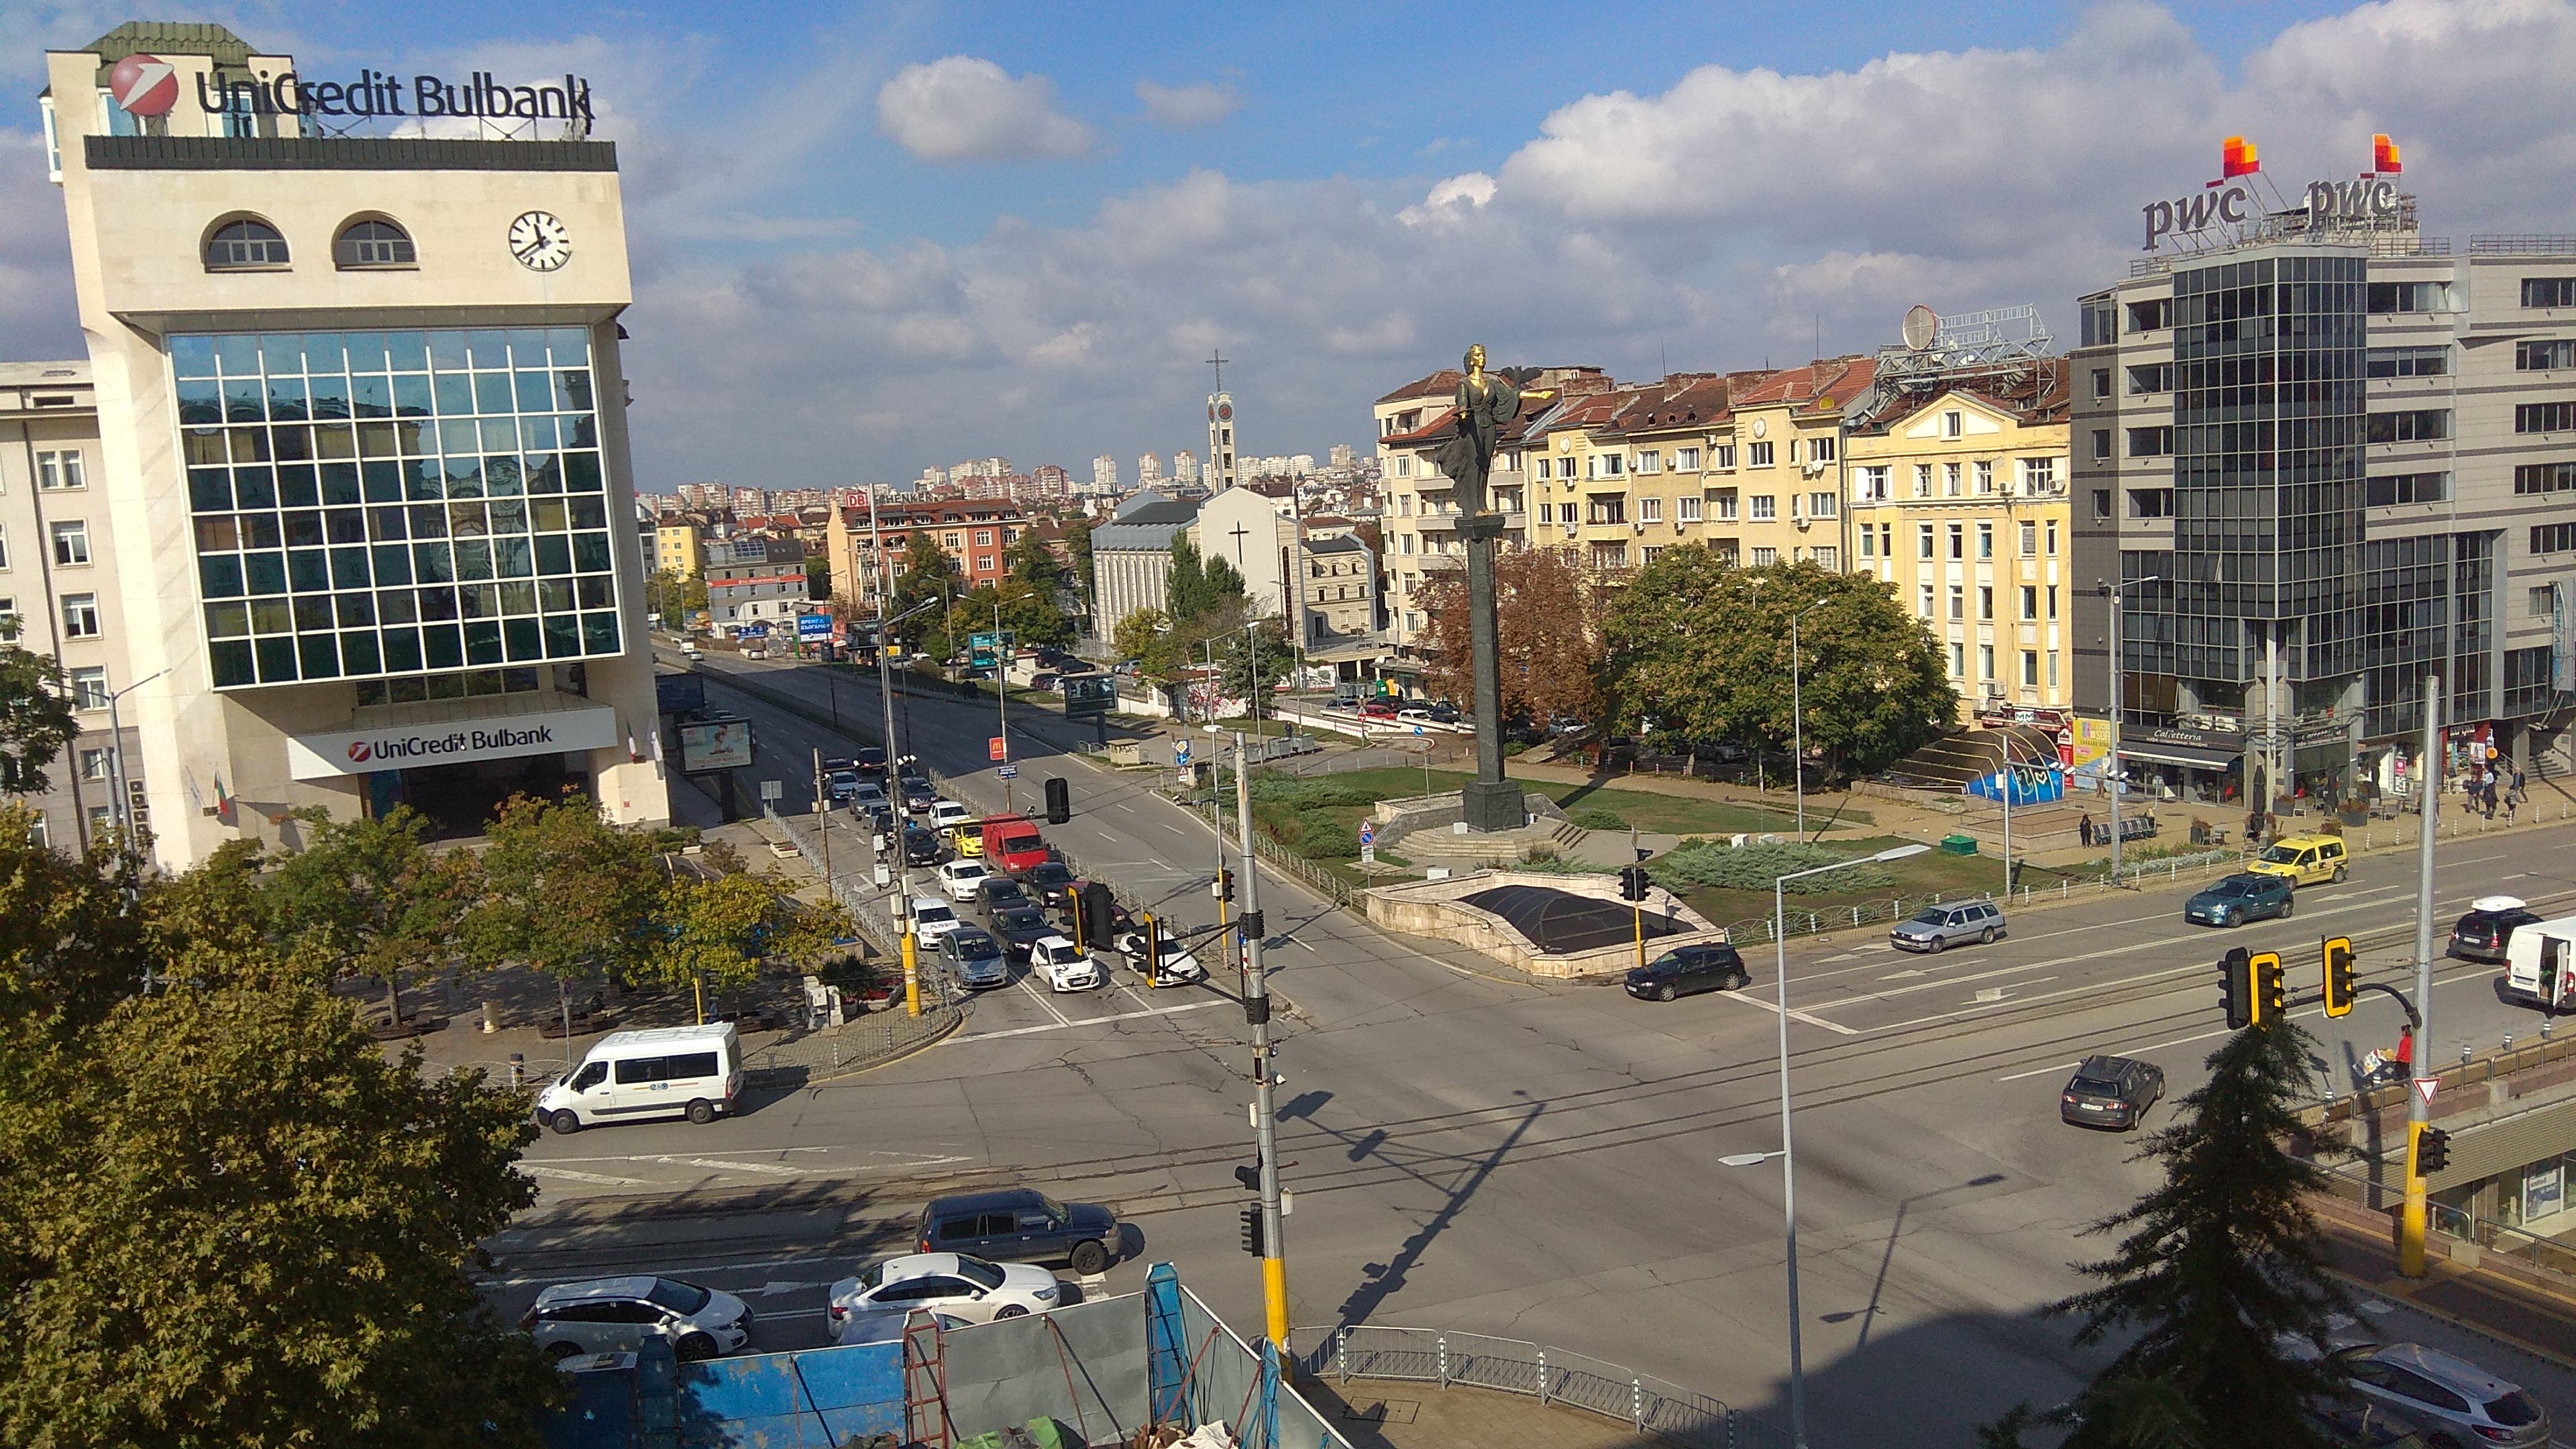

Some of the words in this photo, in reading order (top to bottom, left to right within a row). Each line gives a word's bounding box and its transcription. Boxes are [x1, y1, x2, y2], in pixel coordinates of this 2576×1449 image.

[196, 68, 405, 116] UniCredit
[415, 71, 593, 120] Bulbank
[2143, 186, 2247, 251] pwc
[2308, 179, 2394, 233] pwc
[849, 496, 865, 506] DB
[374, 733, 466, 761] UniCredit
[472, 724, 553, 751] Bulbank
